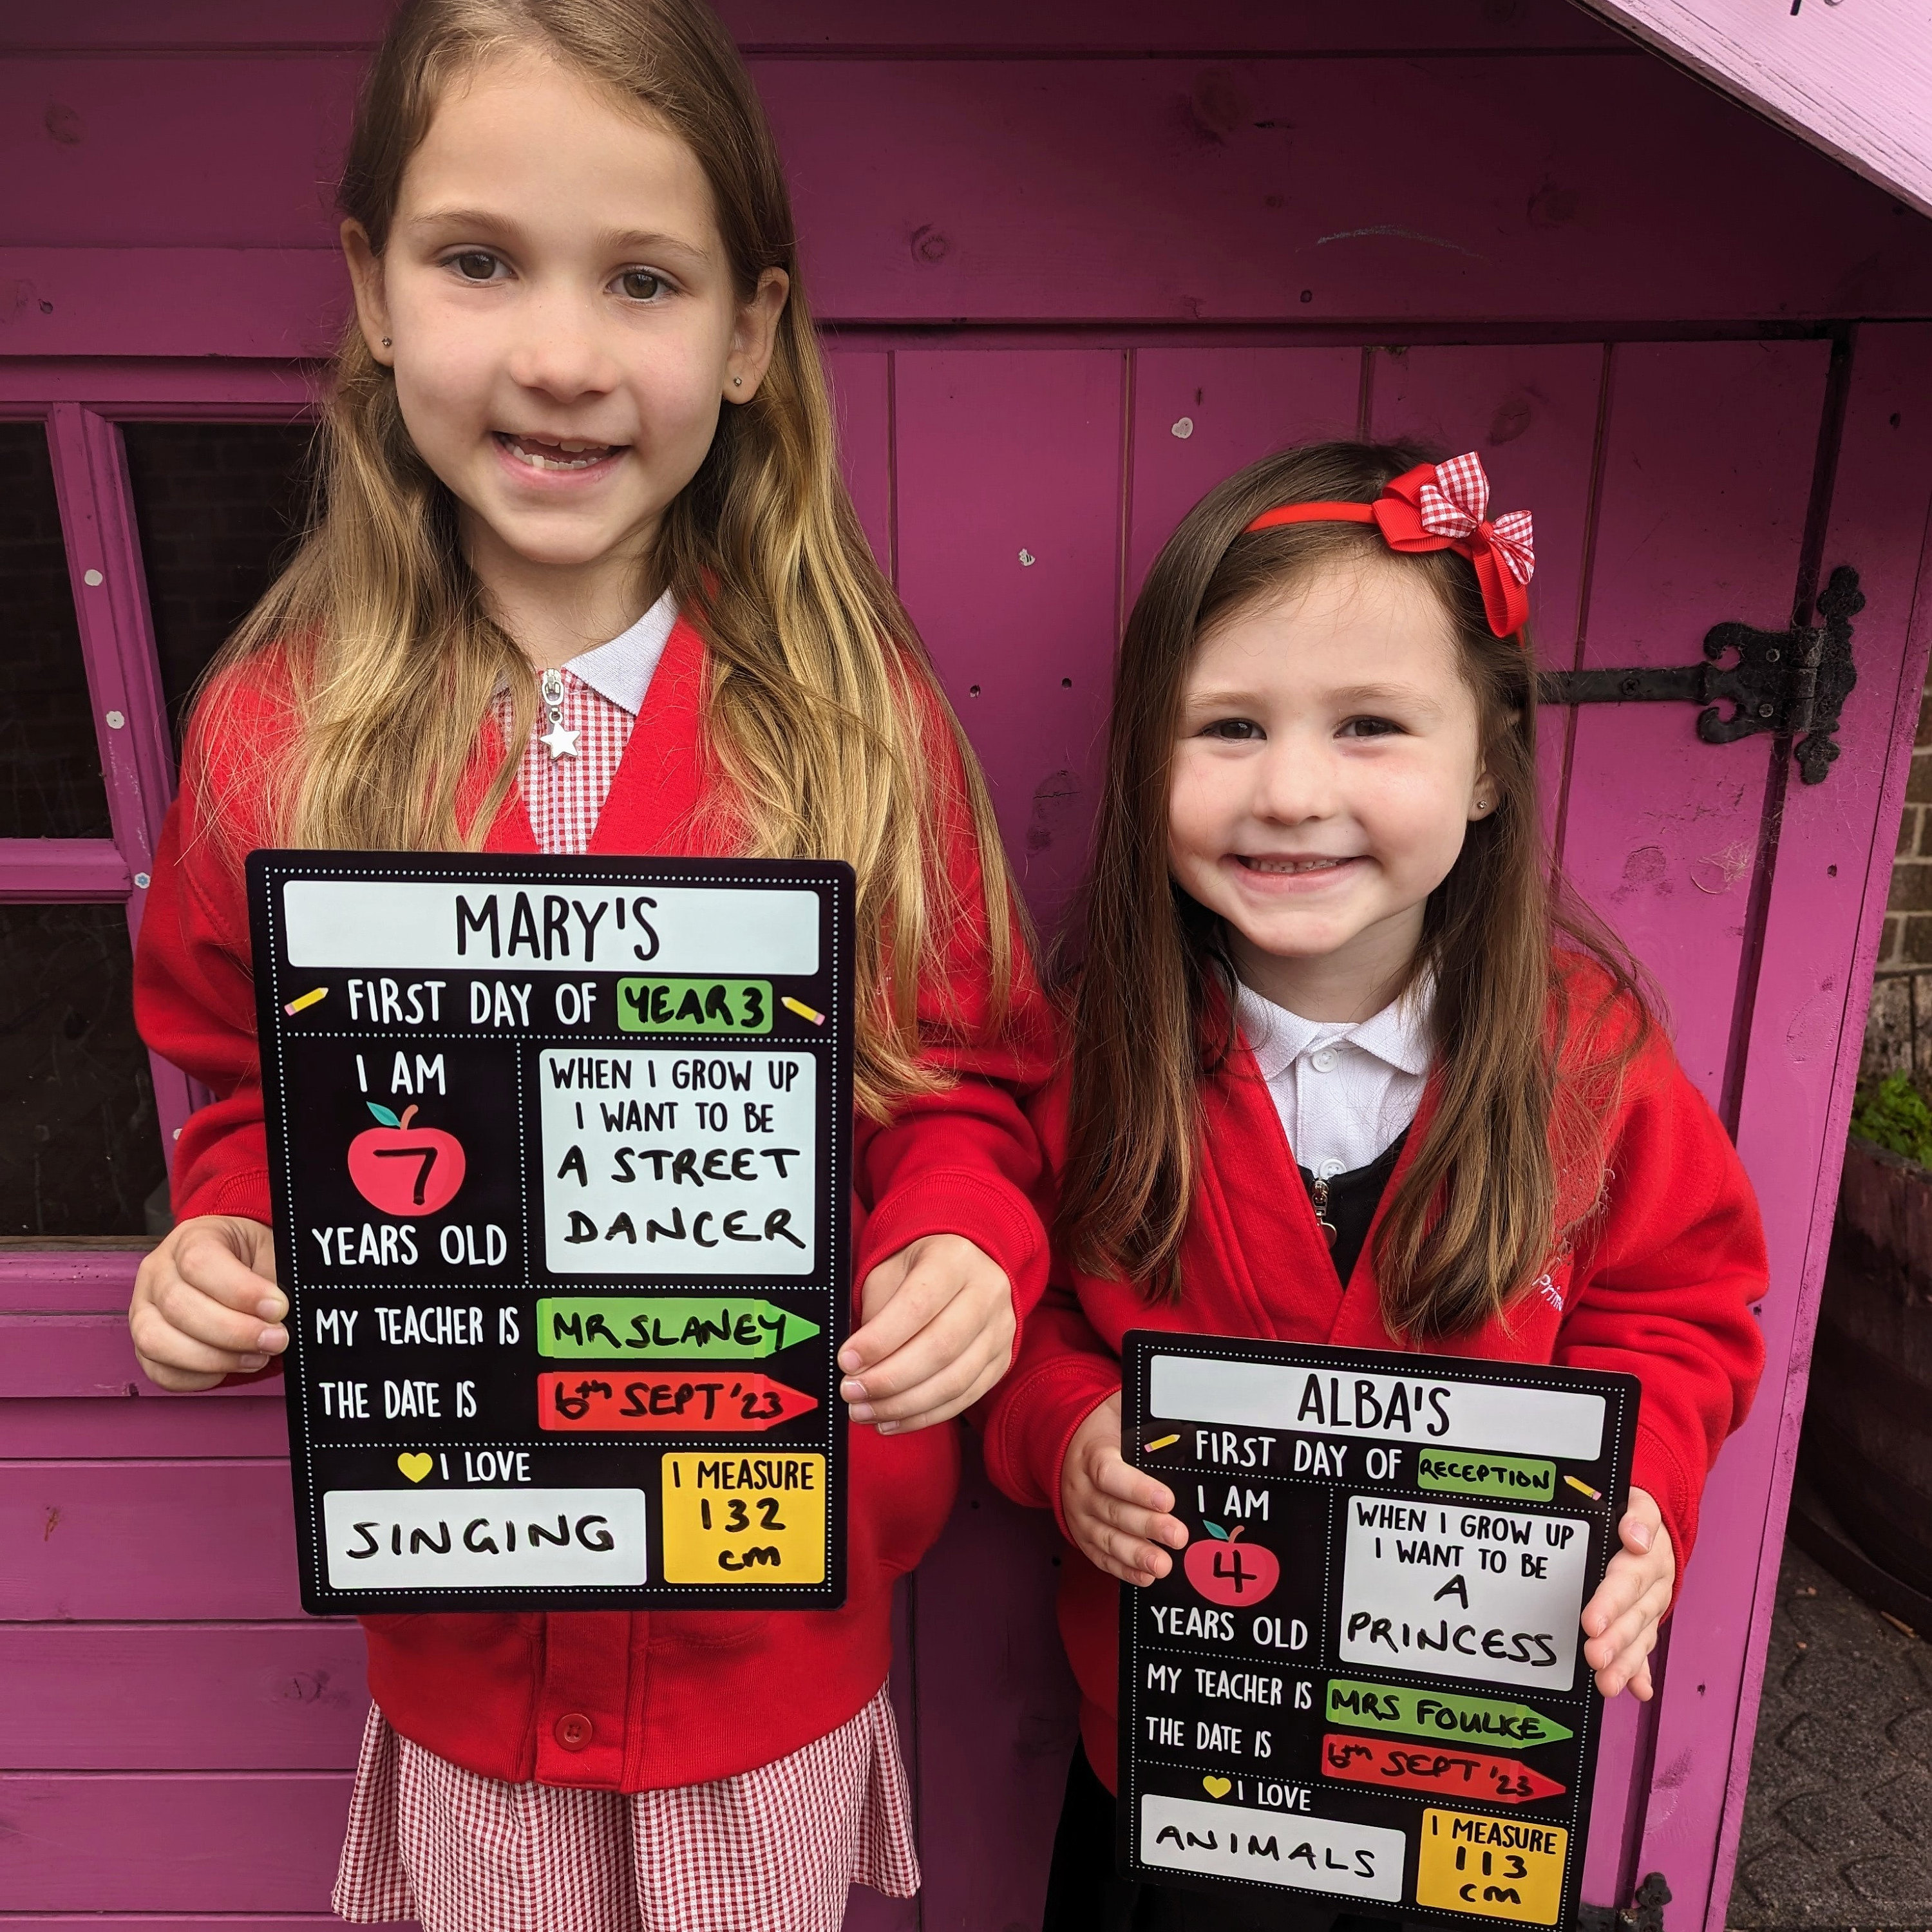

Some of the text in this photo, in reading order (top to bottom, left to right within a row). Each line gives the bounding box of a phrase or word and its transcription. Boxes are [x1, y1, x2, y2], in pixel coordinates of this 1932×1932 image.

[455, 893, 661, 963] MARY'S
[348, 978, 446, 1025] FIRST
[470, 981, 535, 1027] DAY
[555, 981, 598, 1025] OF
[355, 1054, 447, 1095] I AM
[550, 1059, 799, 1094] WHEN I GROW UP
[576, 1102, 775, 1133] I WANT TO BE
[374, 1146, 439, 1206] 7
[557, 1146, 800, 1188] A STREET
[312, 1225, 508, 1267] YEARS OLD
[565, 1207, 806, 1250] DANCER
[316, 1305, 786, 1352] MY TEACHER IS MR SLANEY
[319, 1381, 371, 1419] THE
[384, 1380, 441, 1418] DATE
[456, 1381, 477, 1418] IS
[1297, 1373, 1452, 1437] ALBA'S
[440, 1452, 531, 1482] I LOVE
[672, 1461, 815, 1491] I MEASURE
[1195, 1430, 1550, 1490] FIRST DAY OF RECEPTION
[701, 1498, 787, 1533] 132
[1197, 1485, 1270, 1520] I AM
[346, 1514, 614, 1560] SINGING
[1356, 1502, 1575, 1550] WHEN I GROW UP
[718, 1546, 781, 1573] cm
[1213, 1549, 1258, 1593] 4
[1375, 1537, 1548, 1580] I WANT TO BE
[1434, 1574, 1470, 1609] A
[1150, 1606, 1309, 1651] YEARS OLD
[1347, 1612, 1557, 1667] PRINCESS
[1147, 1663, 1546, 1739] MY TEACHER IS MRS FOULKE
[1146, 1716, 1185, 1747] THE
[1197, 1721, 1242, 1754] DATE
[1255, 1730, 1272, 1758] IS
[1237, 1780, 1311, 1812] I LOVE
[1155, 1825, 1375, 1878] ANIMALS
[1431, 1815, 1558, 1855] I MEASURE
[1455, 1846, 1529, 1879] 113
[1459, 1883, 1522, 1905] cm
